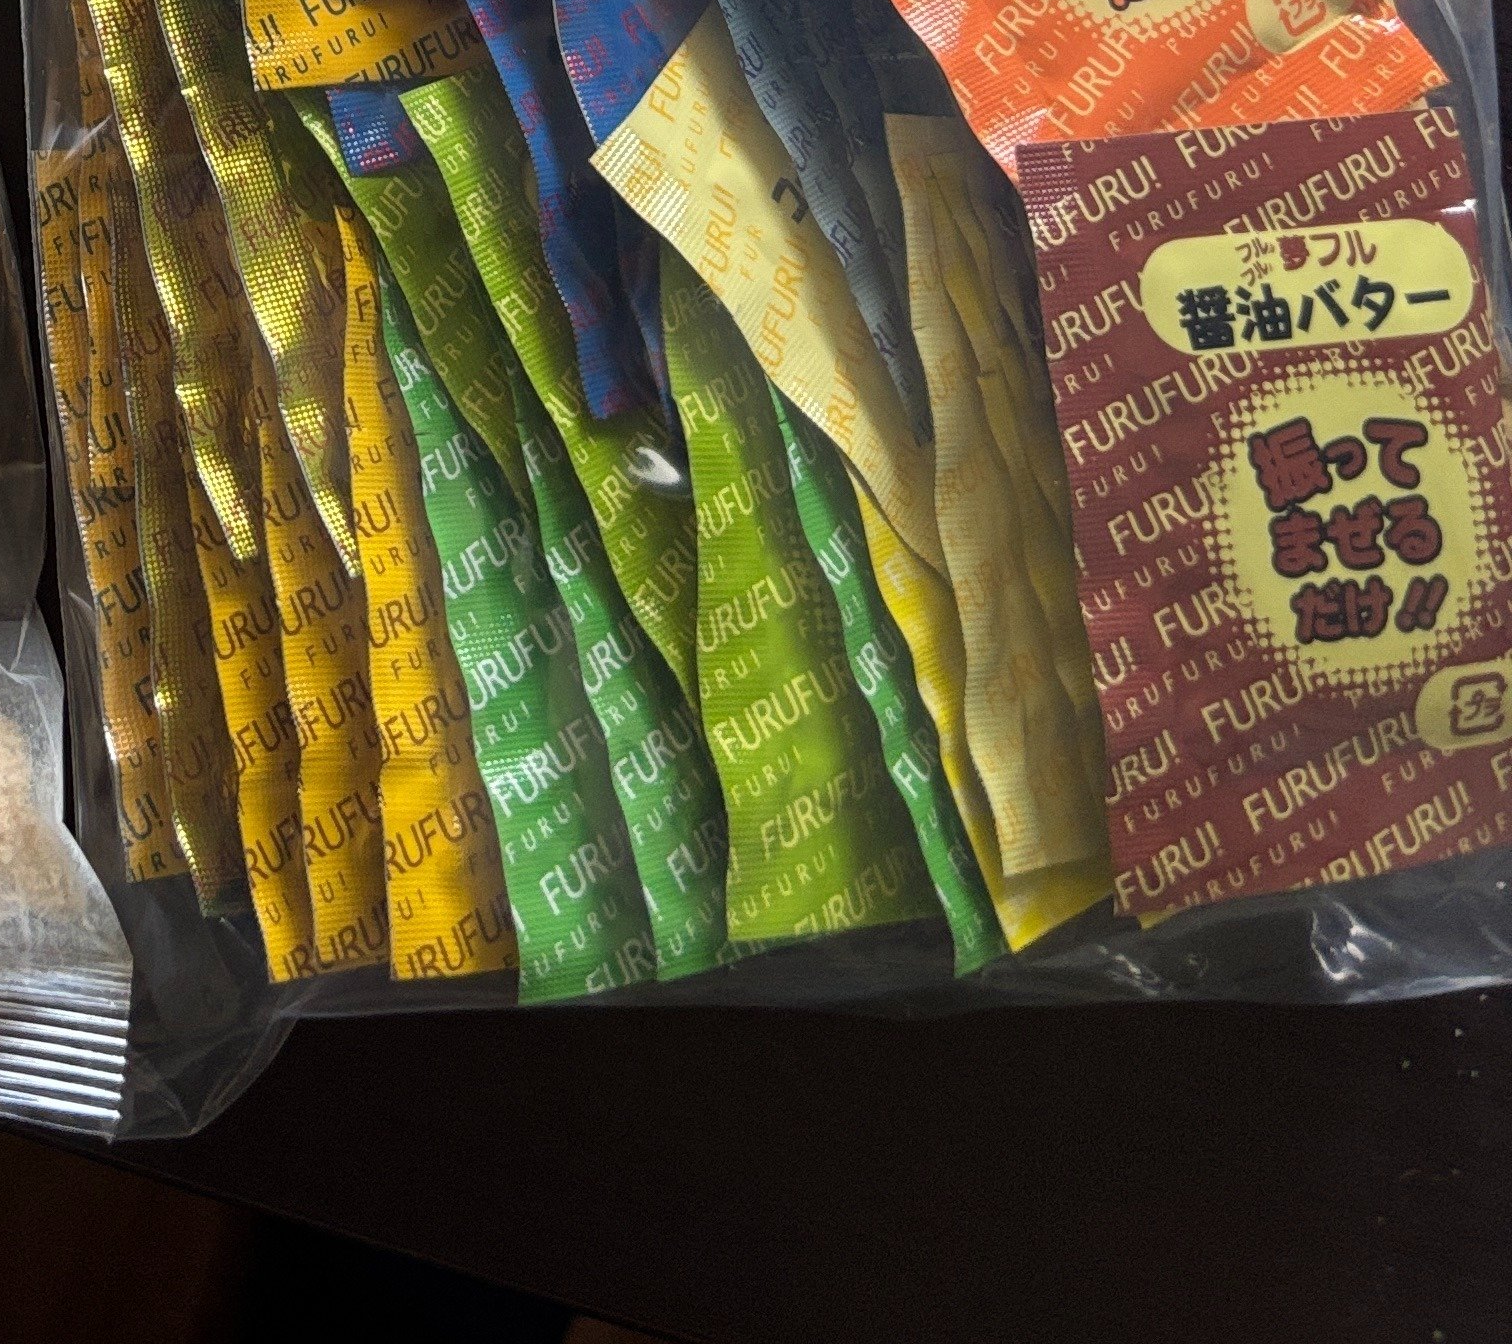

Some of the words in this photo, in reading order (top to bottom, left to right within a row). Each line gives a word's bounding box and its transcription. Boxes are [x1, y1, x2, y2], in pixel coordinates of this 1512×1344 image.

[1109, 152, 1276, 252] FURUFURU!
[1175, 274, 1452, 351] 醤油バター
[1246, 415, 1430, 513] 振って
[1268, 493, 1444, 580] まぜる
